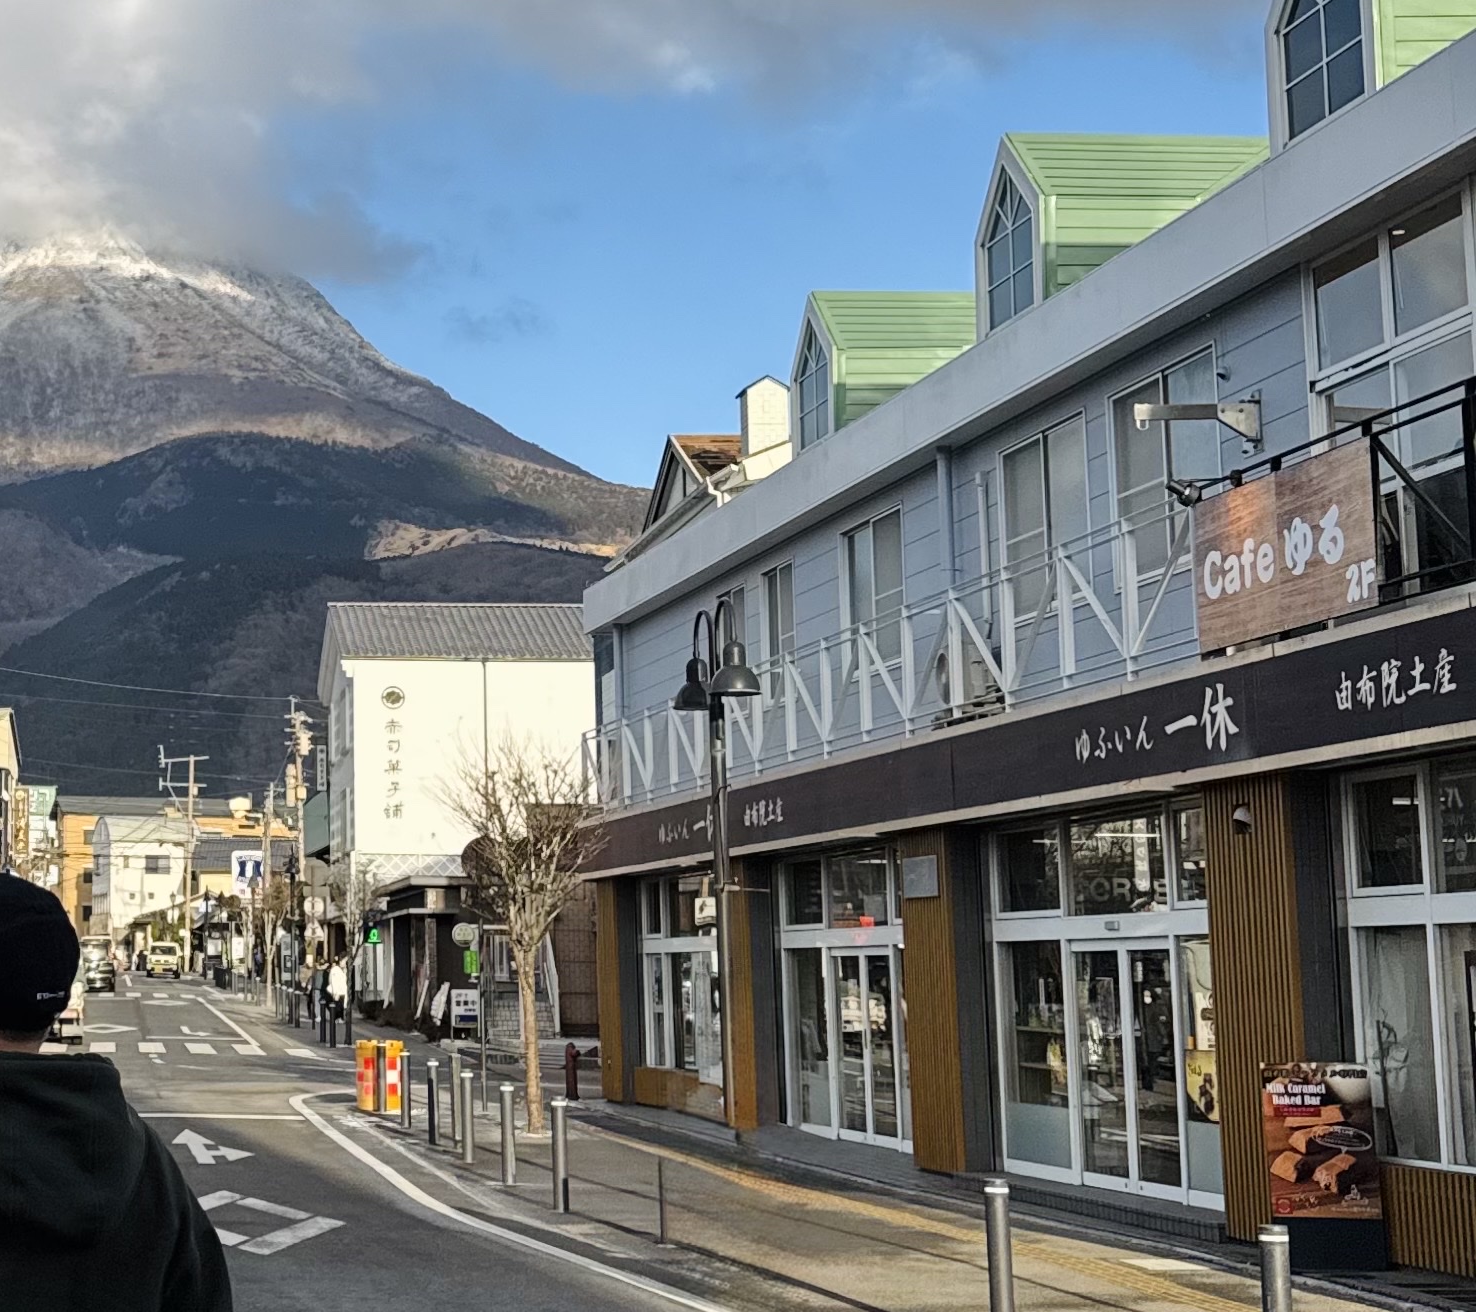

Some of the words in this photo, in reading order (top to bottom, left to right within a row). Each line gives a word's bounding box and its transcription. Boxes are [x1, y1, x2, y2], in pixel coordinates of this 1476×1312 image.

[1204, 538, 1274, 600] Cafe
[1283, 504, 1345, 576] ゆる
[1345, 558, 1376, 604] 2F
[1335, 648, 1457, 711] 由布院土産
[1075, 715, 1154, 764] ゆふいん
[1164, 683, 1239, 751] 一休
[384, 718, 404, 820] 赤司菓子舗
[743, 796, 784, 827] 由布院土産
[1265, 1082, 1286, 1094] Milk
[1287, 1082, 1327, 1095] Caramel
[1271, 1094, 1302, 1105] Baked
[1303, 1094, 1322, 1106] Bar
